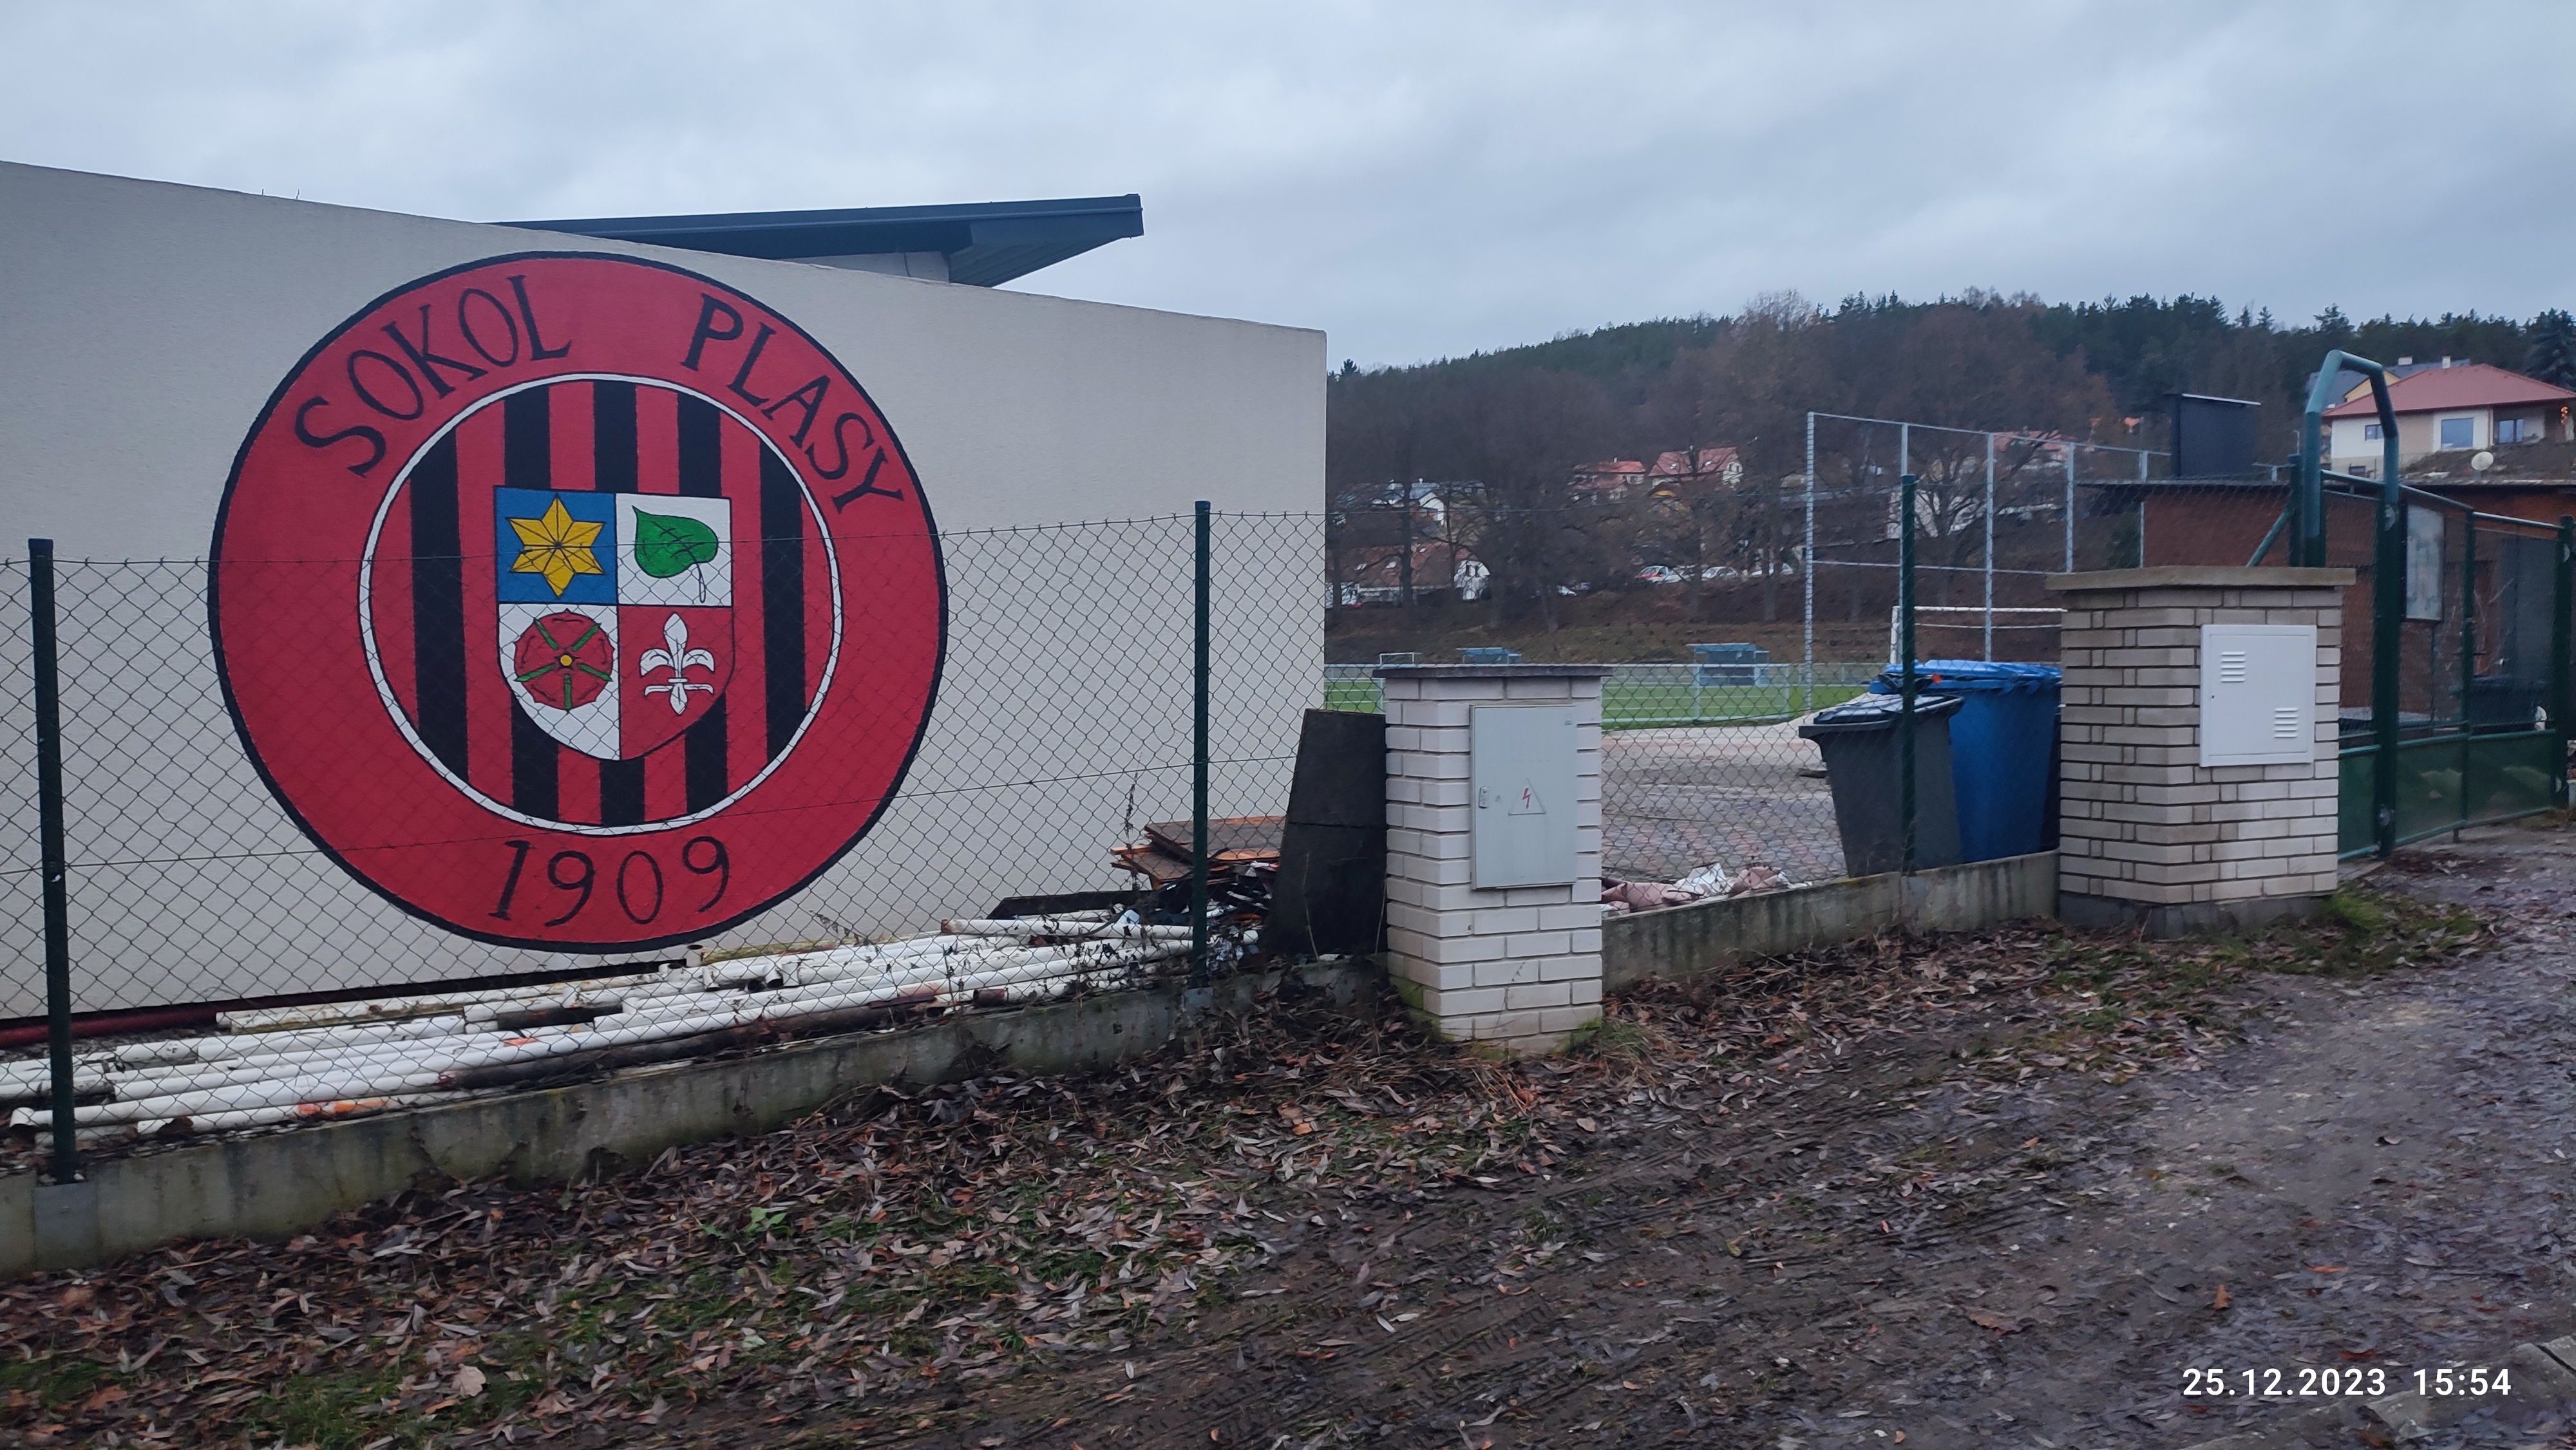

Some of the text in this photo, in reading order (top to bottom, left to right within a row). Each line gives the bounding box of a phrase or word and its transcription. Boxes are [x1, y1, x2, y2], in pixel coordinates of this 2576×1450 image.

[294, 276, 902, 512] SOKOL PLASY
[489, 836, 730, 927] 1909
